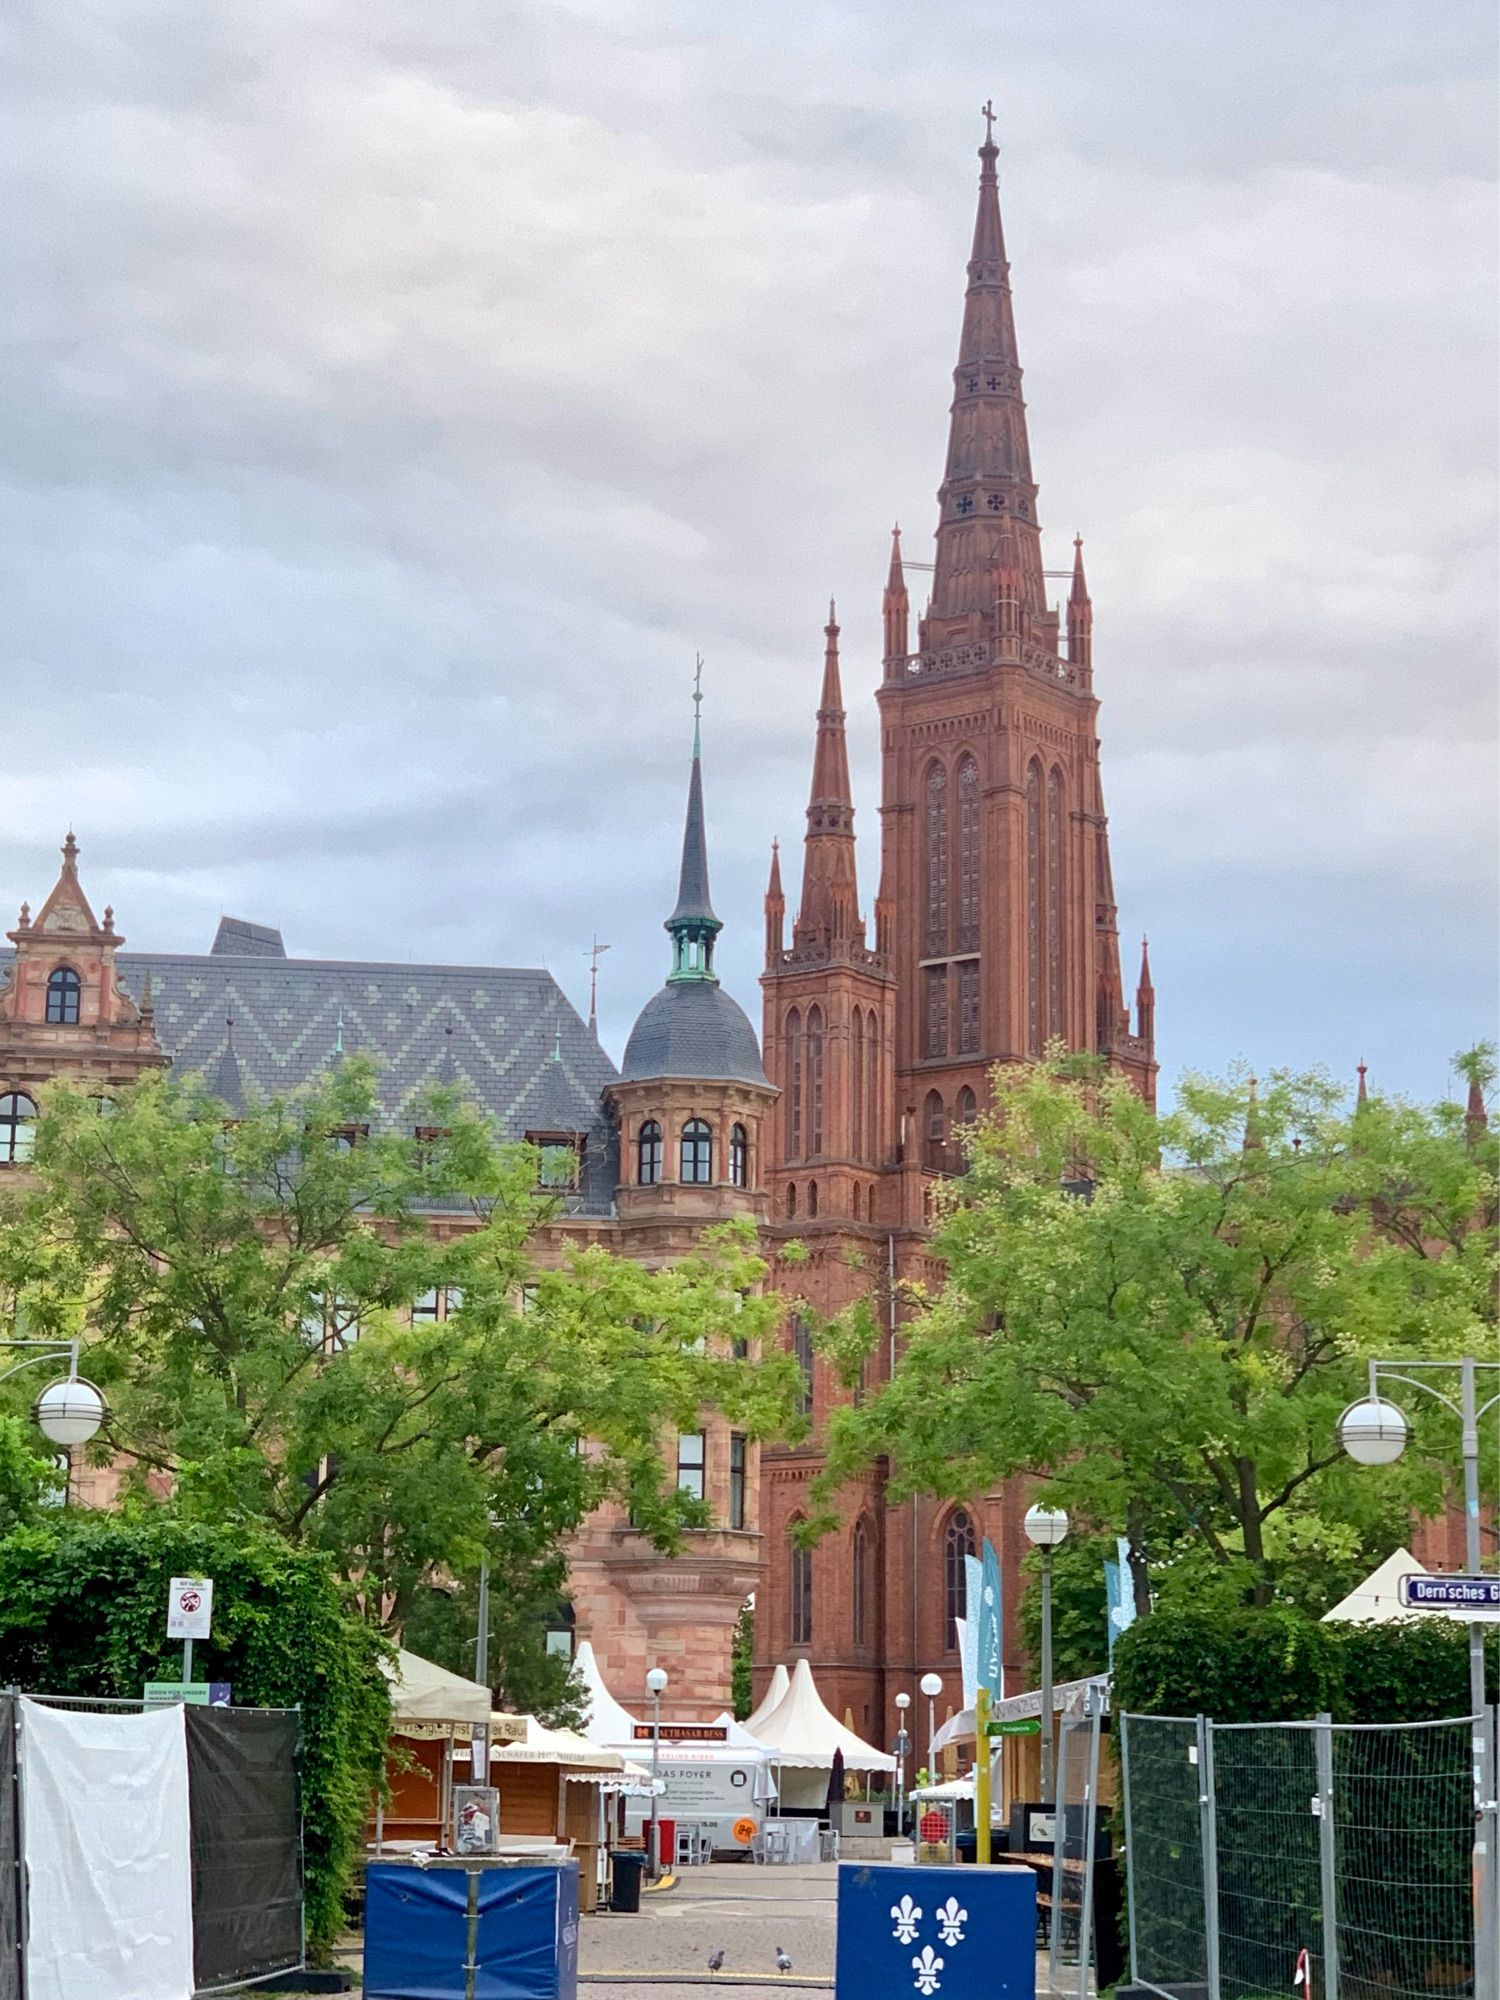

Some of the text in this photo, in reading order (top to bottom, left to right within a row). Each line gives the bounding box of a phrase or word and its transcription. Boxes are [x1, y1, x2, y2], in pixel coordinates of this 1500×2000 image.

[1416, 1582, 1500, 1600] Dern'sches G
[660, 1727, 700, 1738] ALTHASAR
[680, 1770, 712, 1779] FOYER
